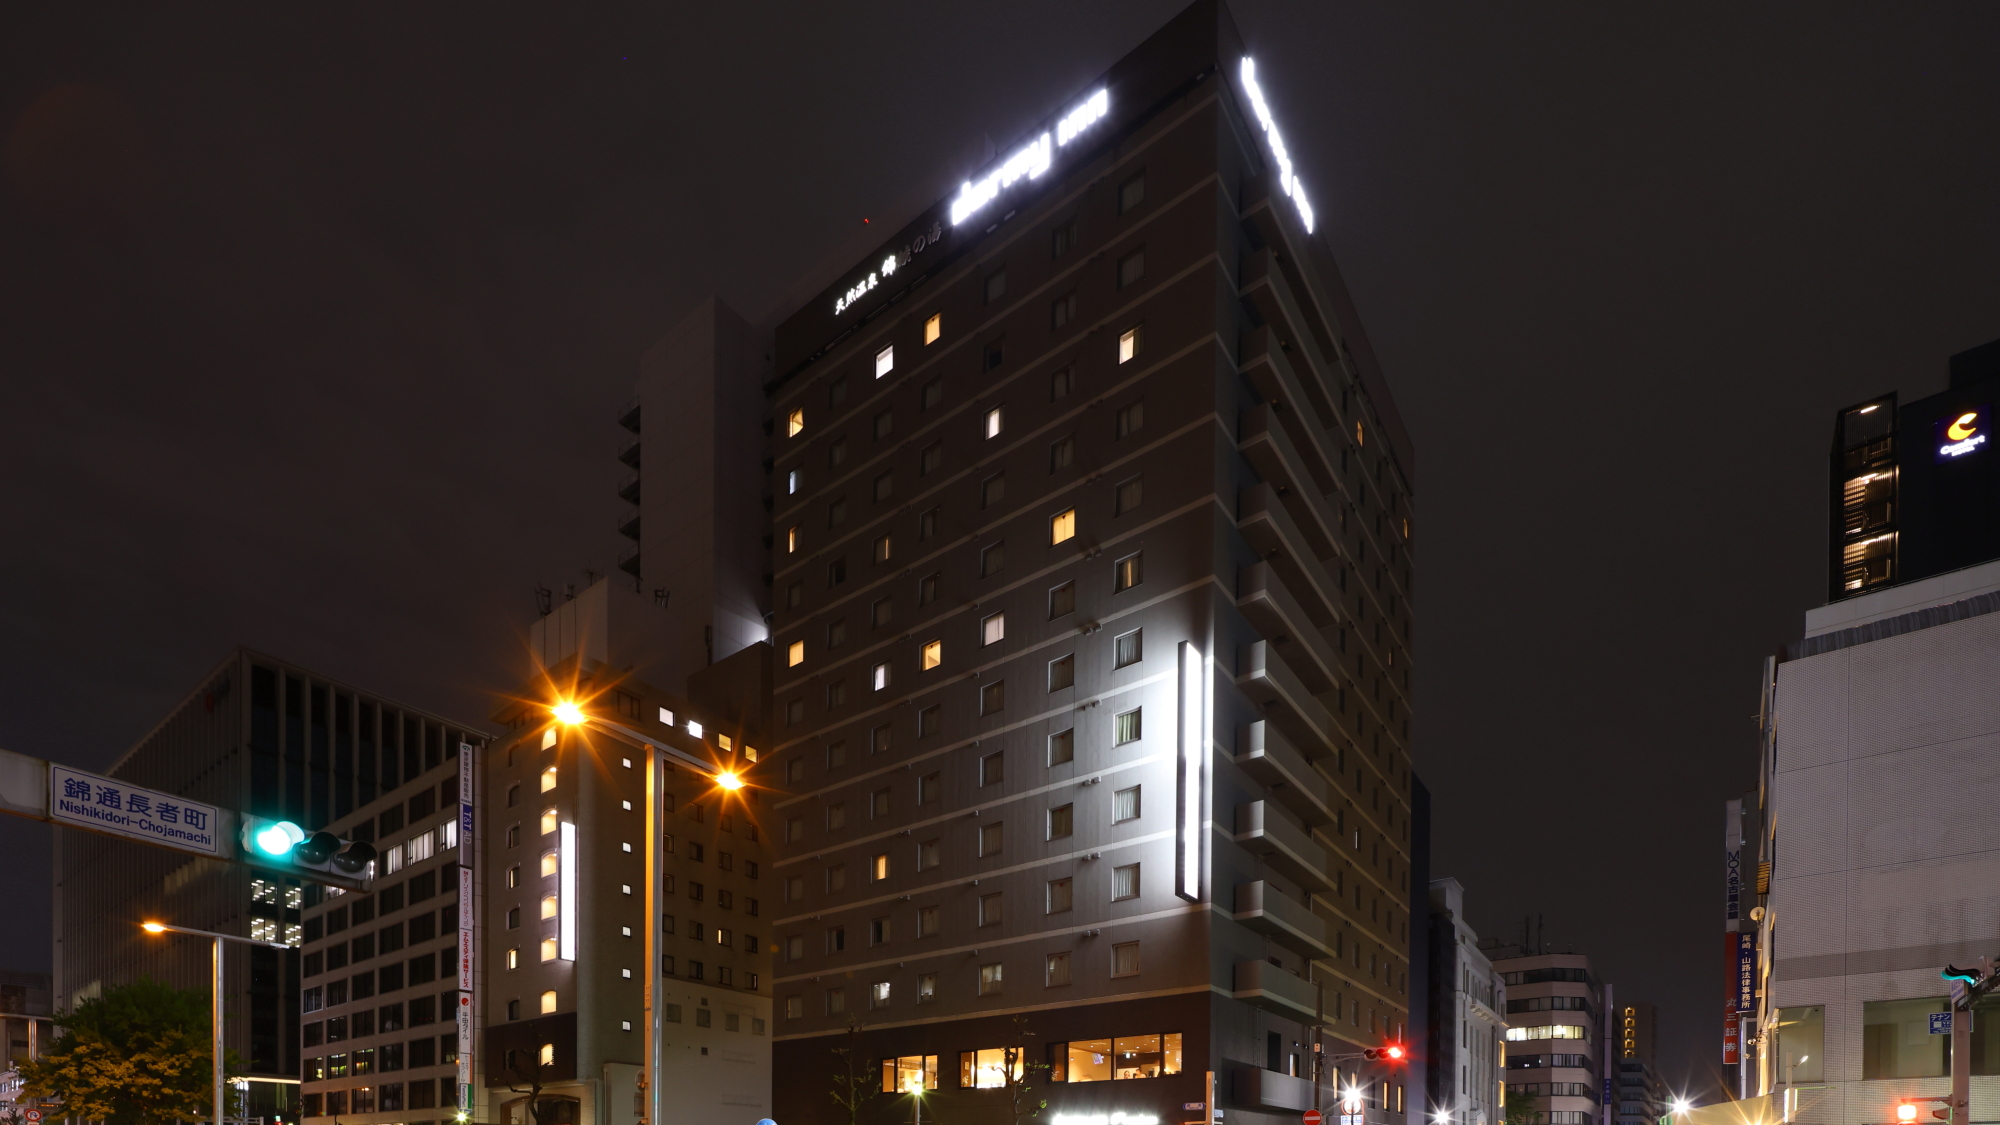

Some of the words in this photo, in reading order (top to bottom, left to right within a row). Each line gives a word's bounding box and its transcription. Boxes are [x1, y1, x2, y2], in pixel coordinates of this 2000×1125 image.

[63, 777, 208, 831] 錦通長者町
[463, 811, 472, 831] T&T
[1725, 997, 1738, 1052] 丸三証券
